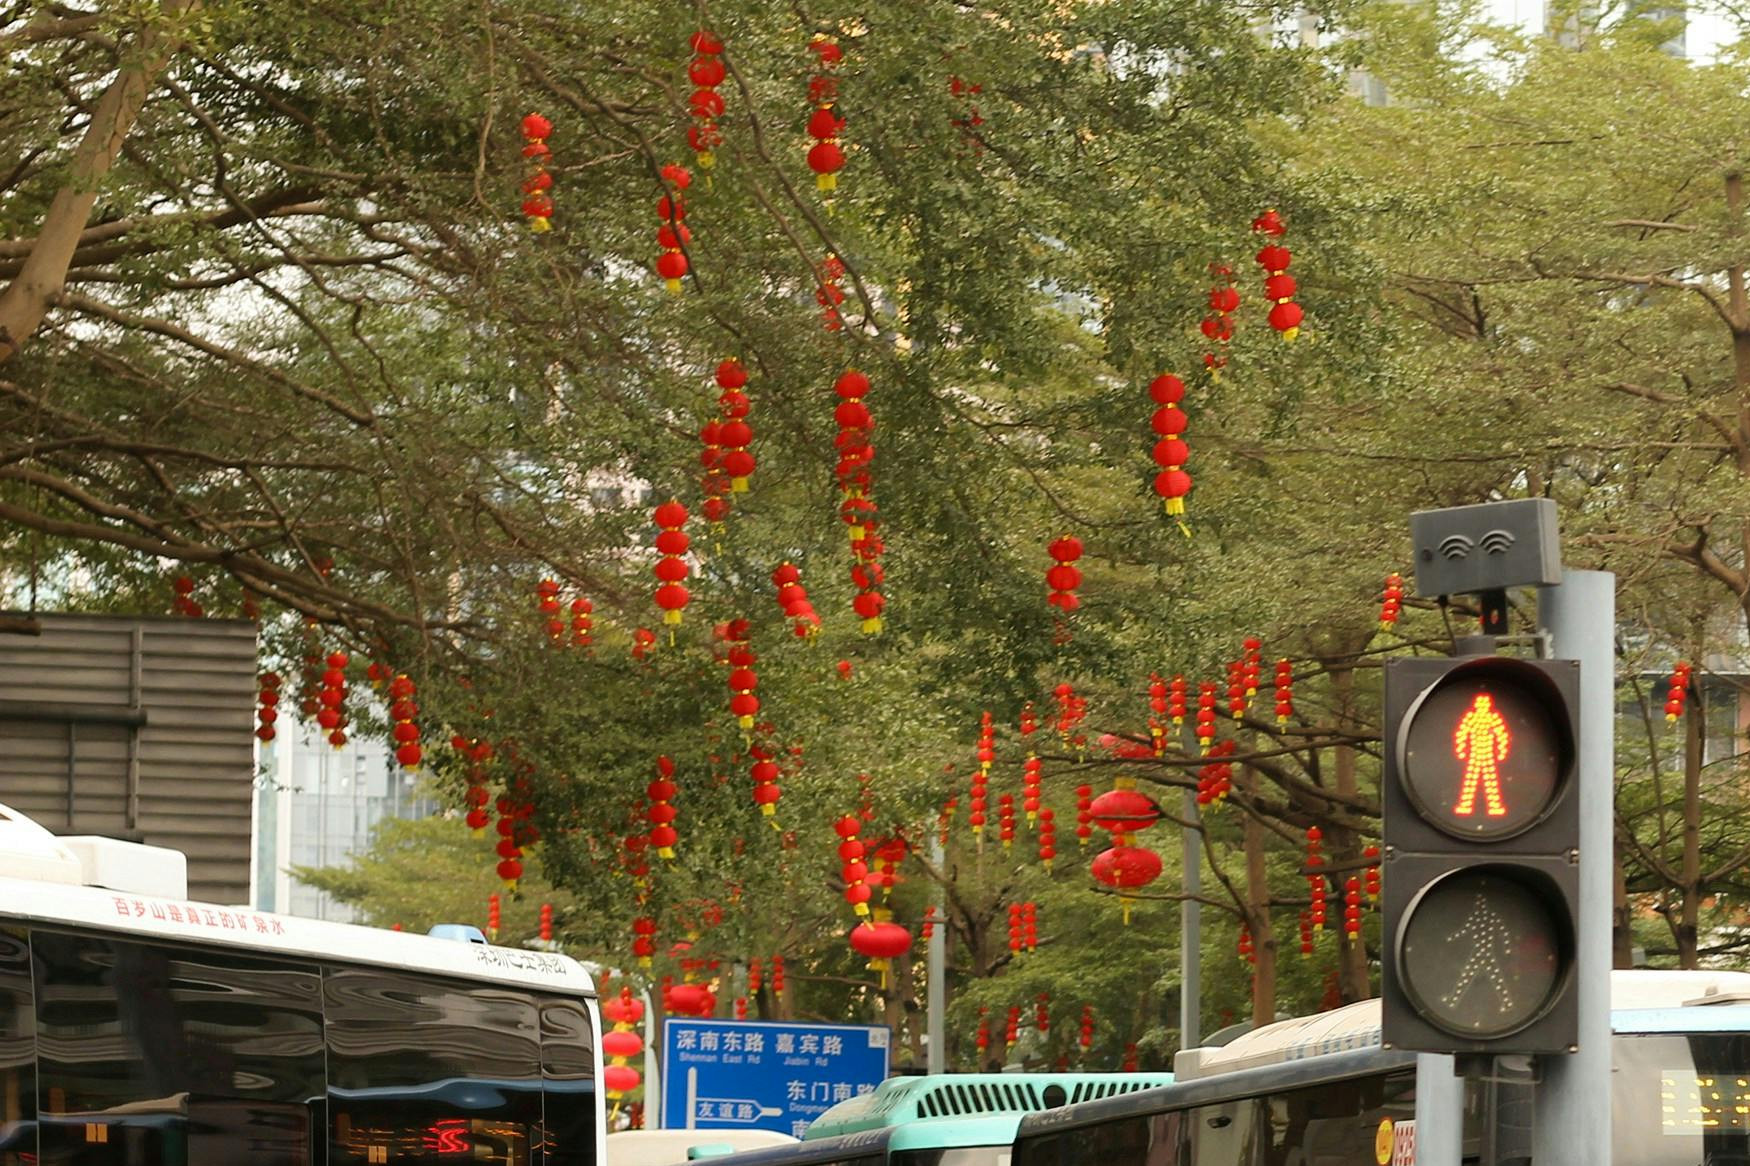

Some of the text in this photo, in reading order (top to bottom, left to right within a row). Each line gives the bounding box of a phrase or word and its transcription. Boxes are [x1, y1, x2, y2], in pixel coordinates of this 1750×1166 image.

[676, 1029, 764, 1053] 深南东路
[775, 1033, 844, 1056] 嘉宾路
[679, 1052, 760, 1065] Shennan East Rd
[698, 1101, 753, 1119] 友谊路
